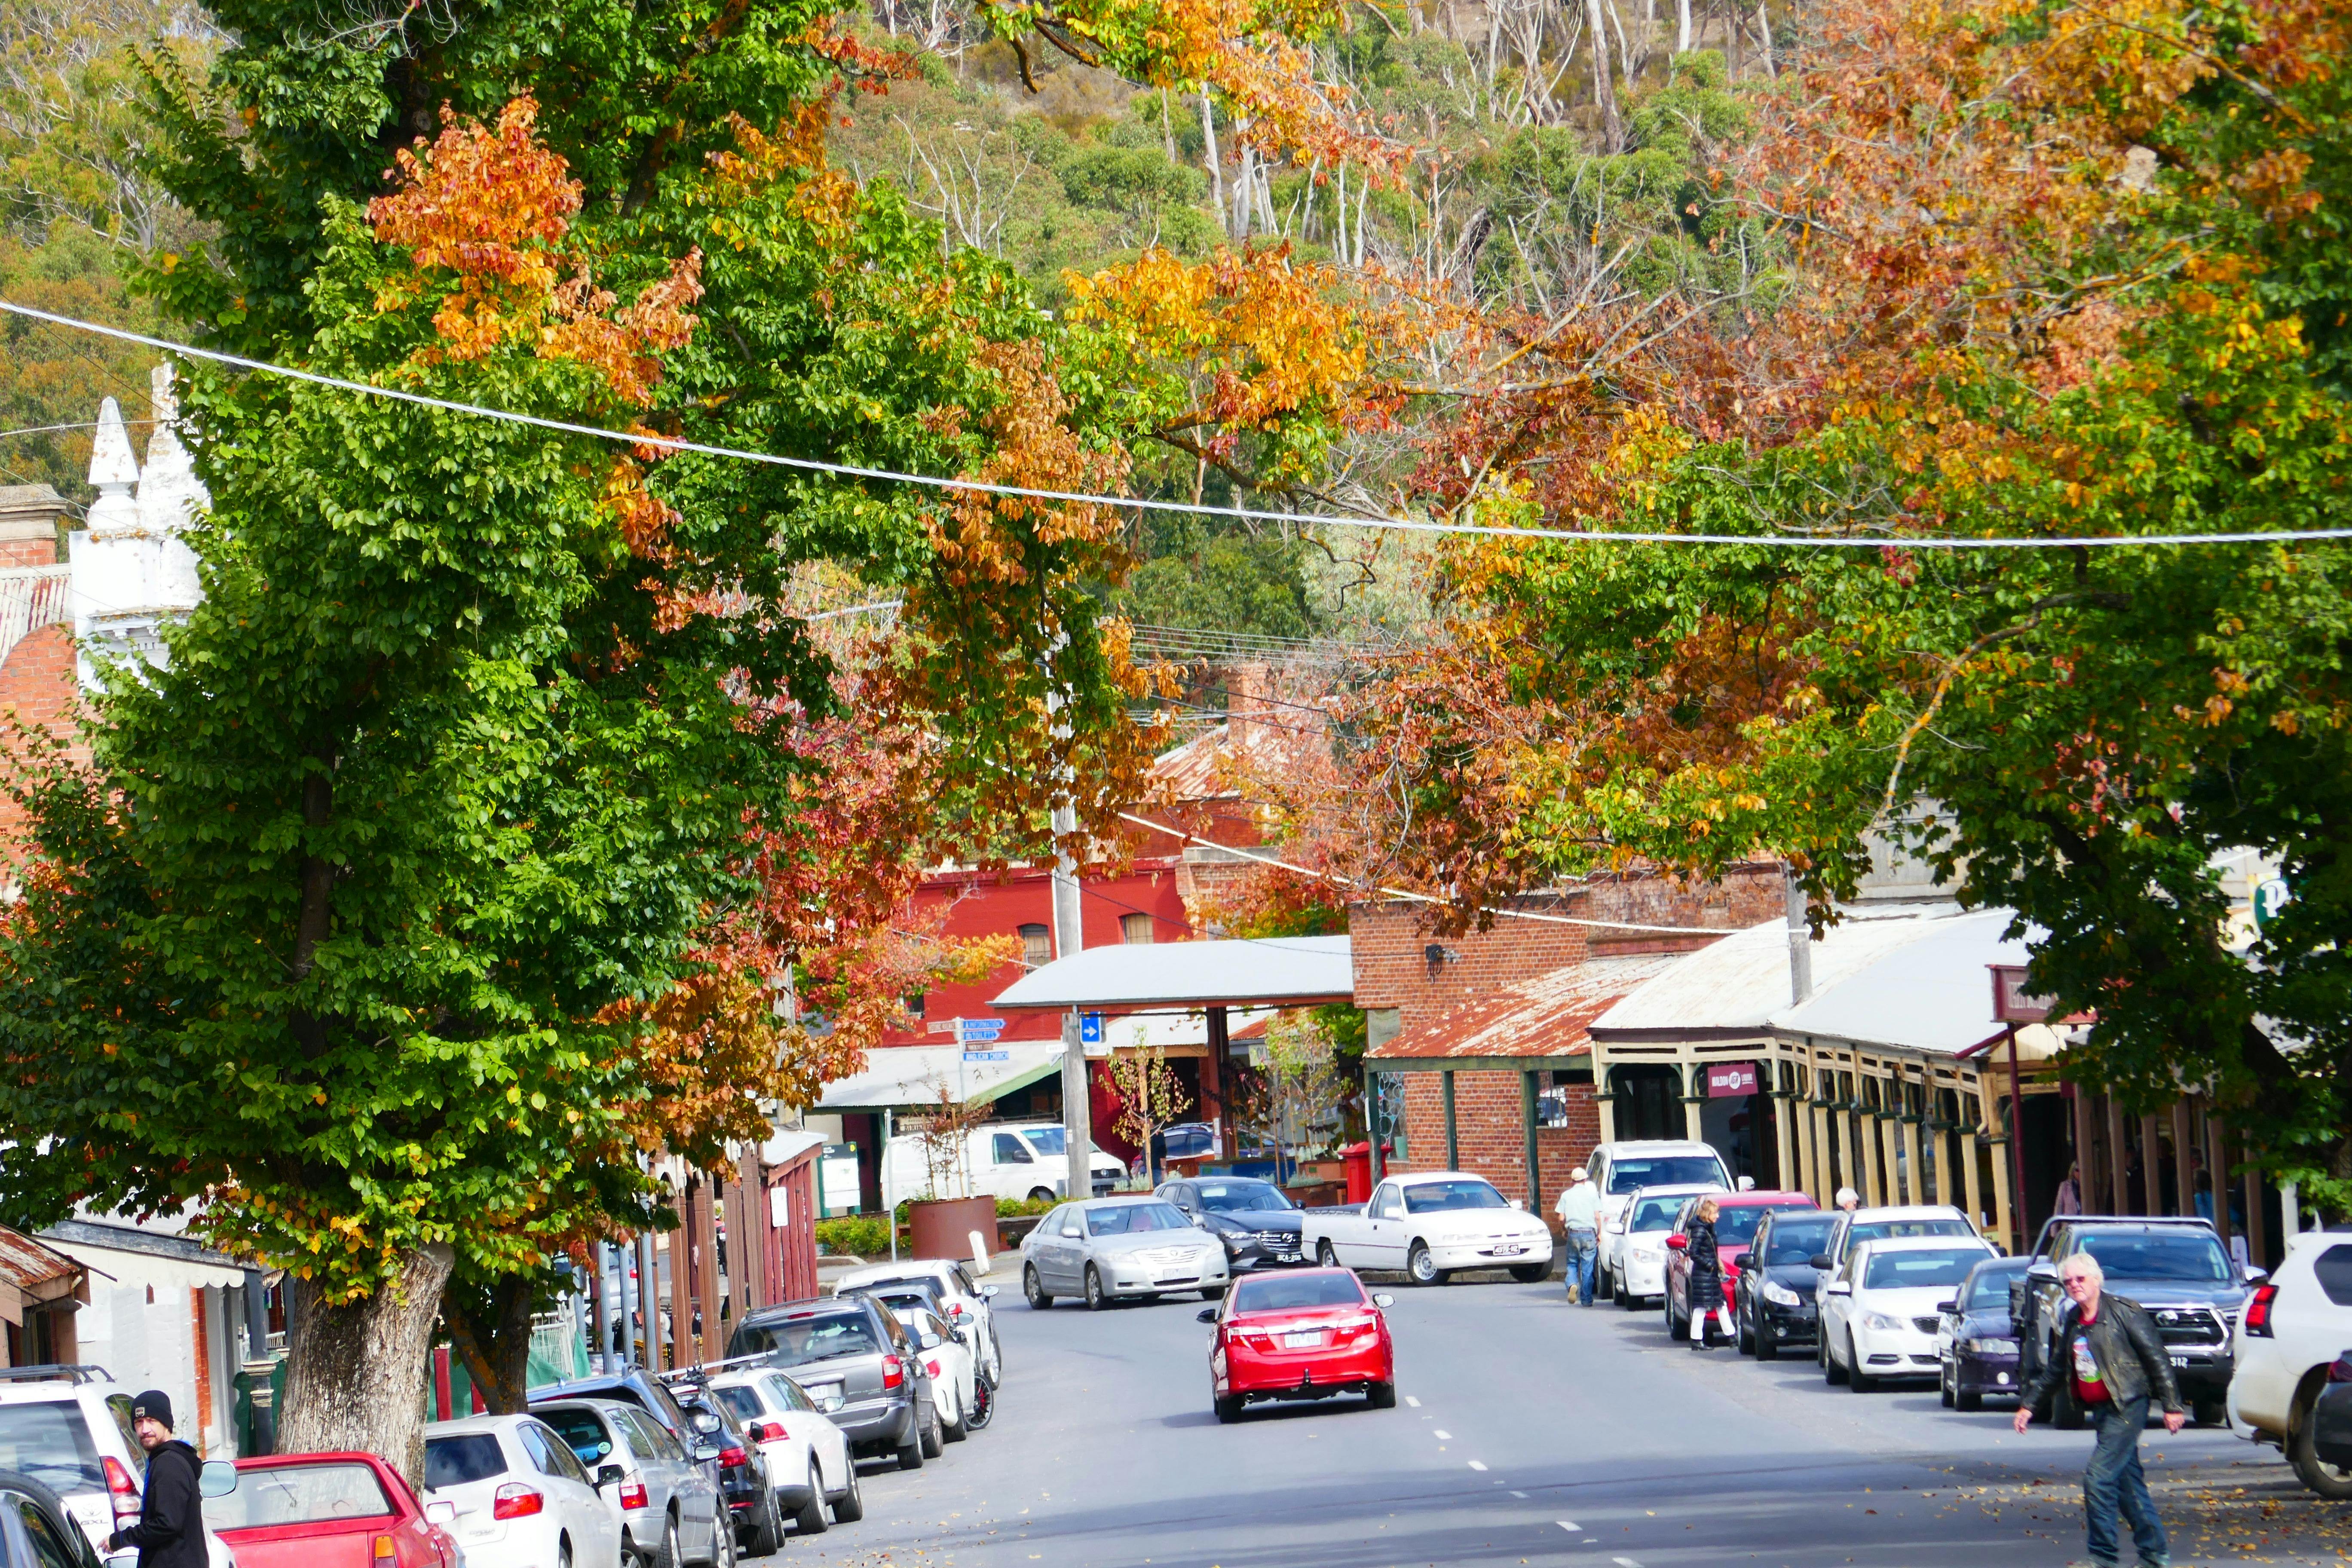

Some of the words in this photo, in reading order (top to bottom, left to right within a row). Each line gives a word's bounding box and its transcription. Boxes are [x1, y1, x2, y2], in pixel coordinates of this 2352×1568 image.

[969, 1020, 1000, 1029] INFORMATION
[990, 1052, 1009, 1060] CHURCH
[1712, 1075, 1728, 1087] MALDON
[1730, 1075, 1739, 1084] IGA
